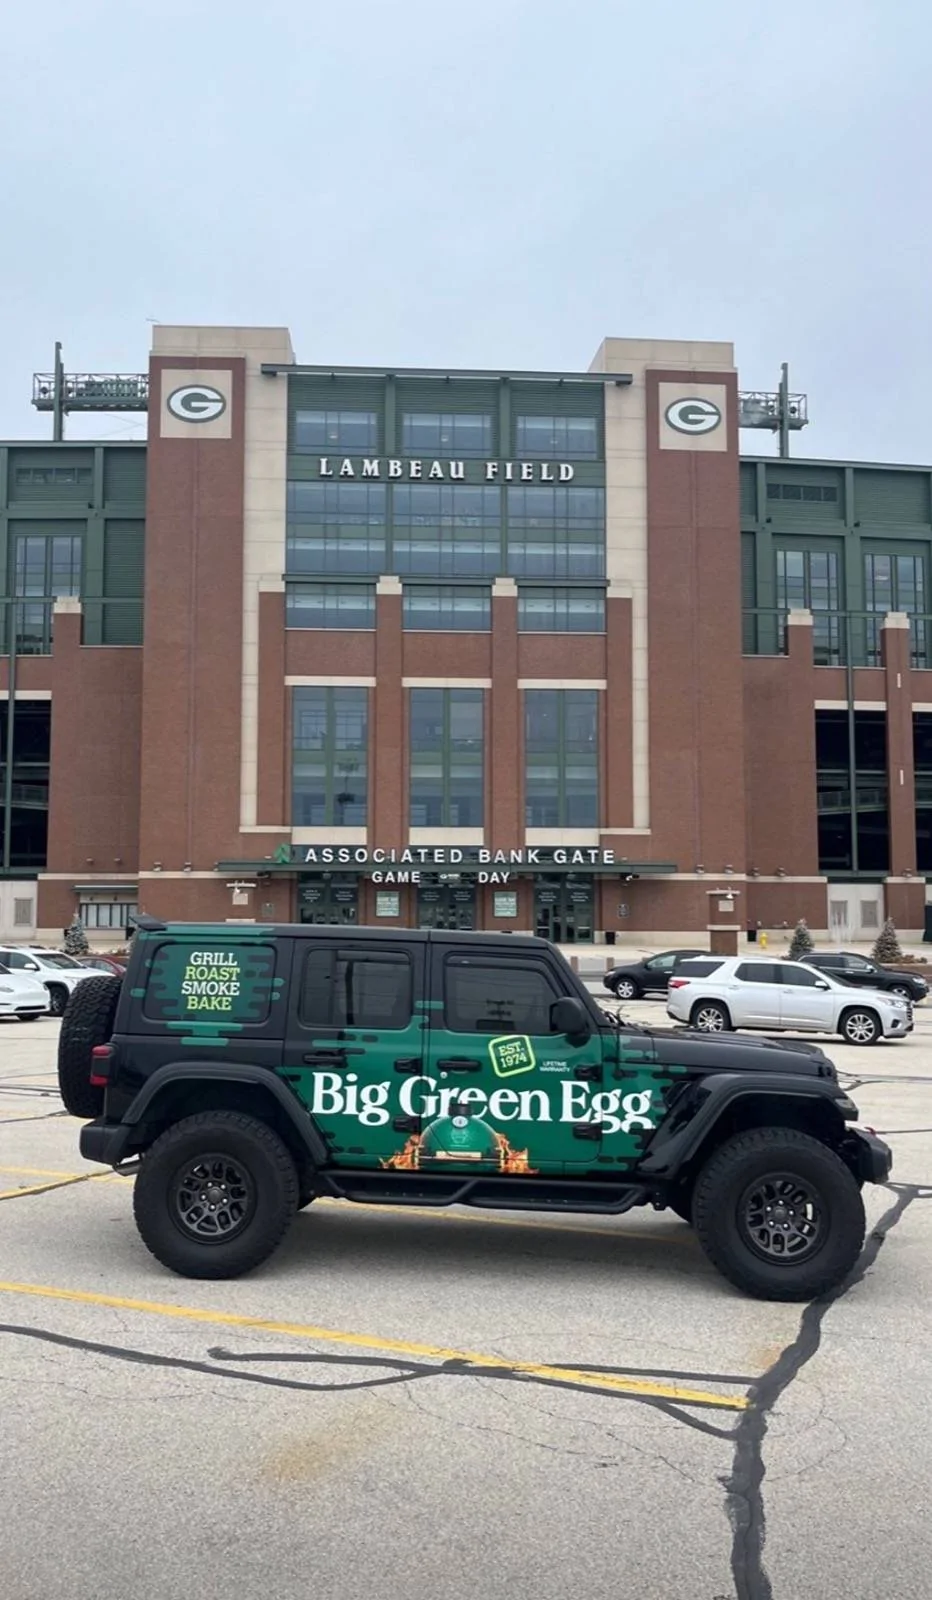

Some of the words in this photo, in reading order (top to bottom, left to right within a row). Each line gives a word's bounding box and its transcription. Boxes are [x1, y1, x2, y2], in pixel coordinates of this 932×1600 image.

[319, 457, 465, 479] LAMBEAU
[485, 462, 575, 481] FIELD
[305, 849, 463, 863] ASSOCIATED
[479, 849, 541, 864] BANK
[553, 849, 615, 864] GATE
[371, 870, 421, 884] GAME
[478, 871, 511, 884] DAY
[190, 952, 238, 966] GRILL
[184, 966, 240, 981] ROAST
[181, 981, 240, 996] SMOKE
[187, 996, 232, 1011] BAKE
[498, 1041, 525, 1057] EST.
[500, 1052, 528, 1068] 1974
[311, 1071, 391, 1127] Big
[399, 1075, 553, 1122] Green
[559, 1080, 656, 1134] Egg
